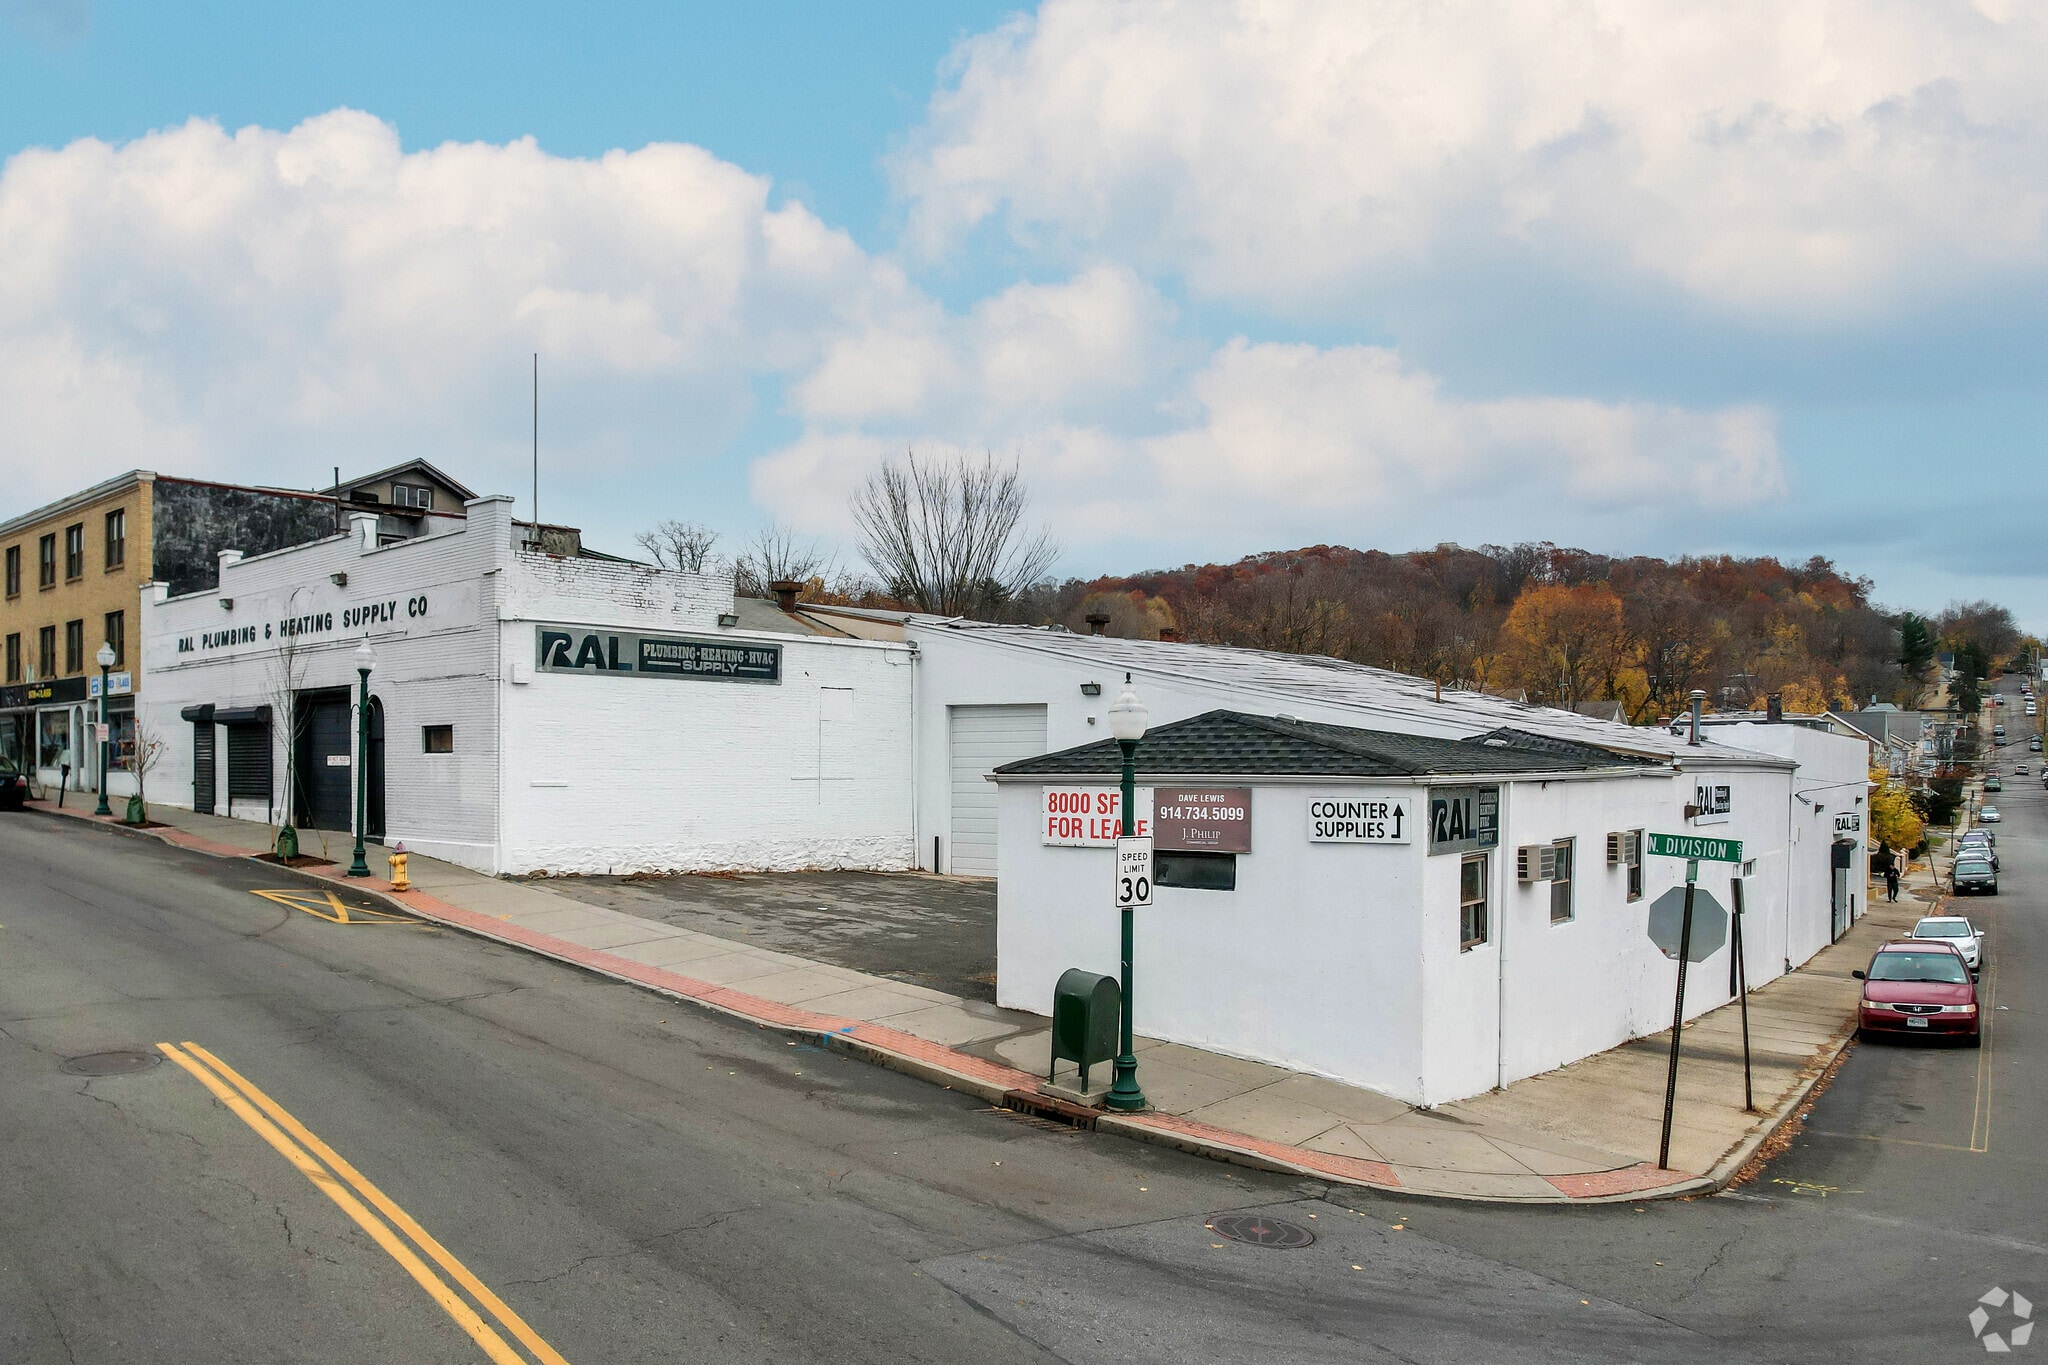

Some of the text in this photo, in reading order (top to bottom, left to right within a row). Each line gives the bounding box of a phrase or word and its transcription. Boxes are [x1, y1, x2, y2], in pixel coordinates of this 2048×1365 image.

[178, 595, 428, 653] RAL PLUMBING & HEATING SUPPLY CO
[542, 631, 633, 671] RAL
[682, 659, 739, 673] SUPPLY
[1048, 792, 1120, 815] 8000 SF
[1178, 794, 1225, 803] DAVE LEWIS
[1697, 785, 1715, 815] RAL
[1160, 806, 1245, 821] 914.734.5099
[1311, 802, 1389, 819] COUNTER
[1048, 816, 1148, 840] FOR LEAE
[1432, 798, 1477, 842] RAL
[1835, 817, 1852, 831] RAL
[1182, 827, 1189, 841] J.
[1315, 821, 1385, 839] SUPPLIES
[1121, 852, 1148, 862] SPEED
[1648, 835, 1743, 861] N. DIVISION ST
[1123, 864, 1145, 874] LIMIT
[1119, 876, 1150, 903] 30
